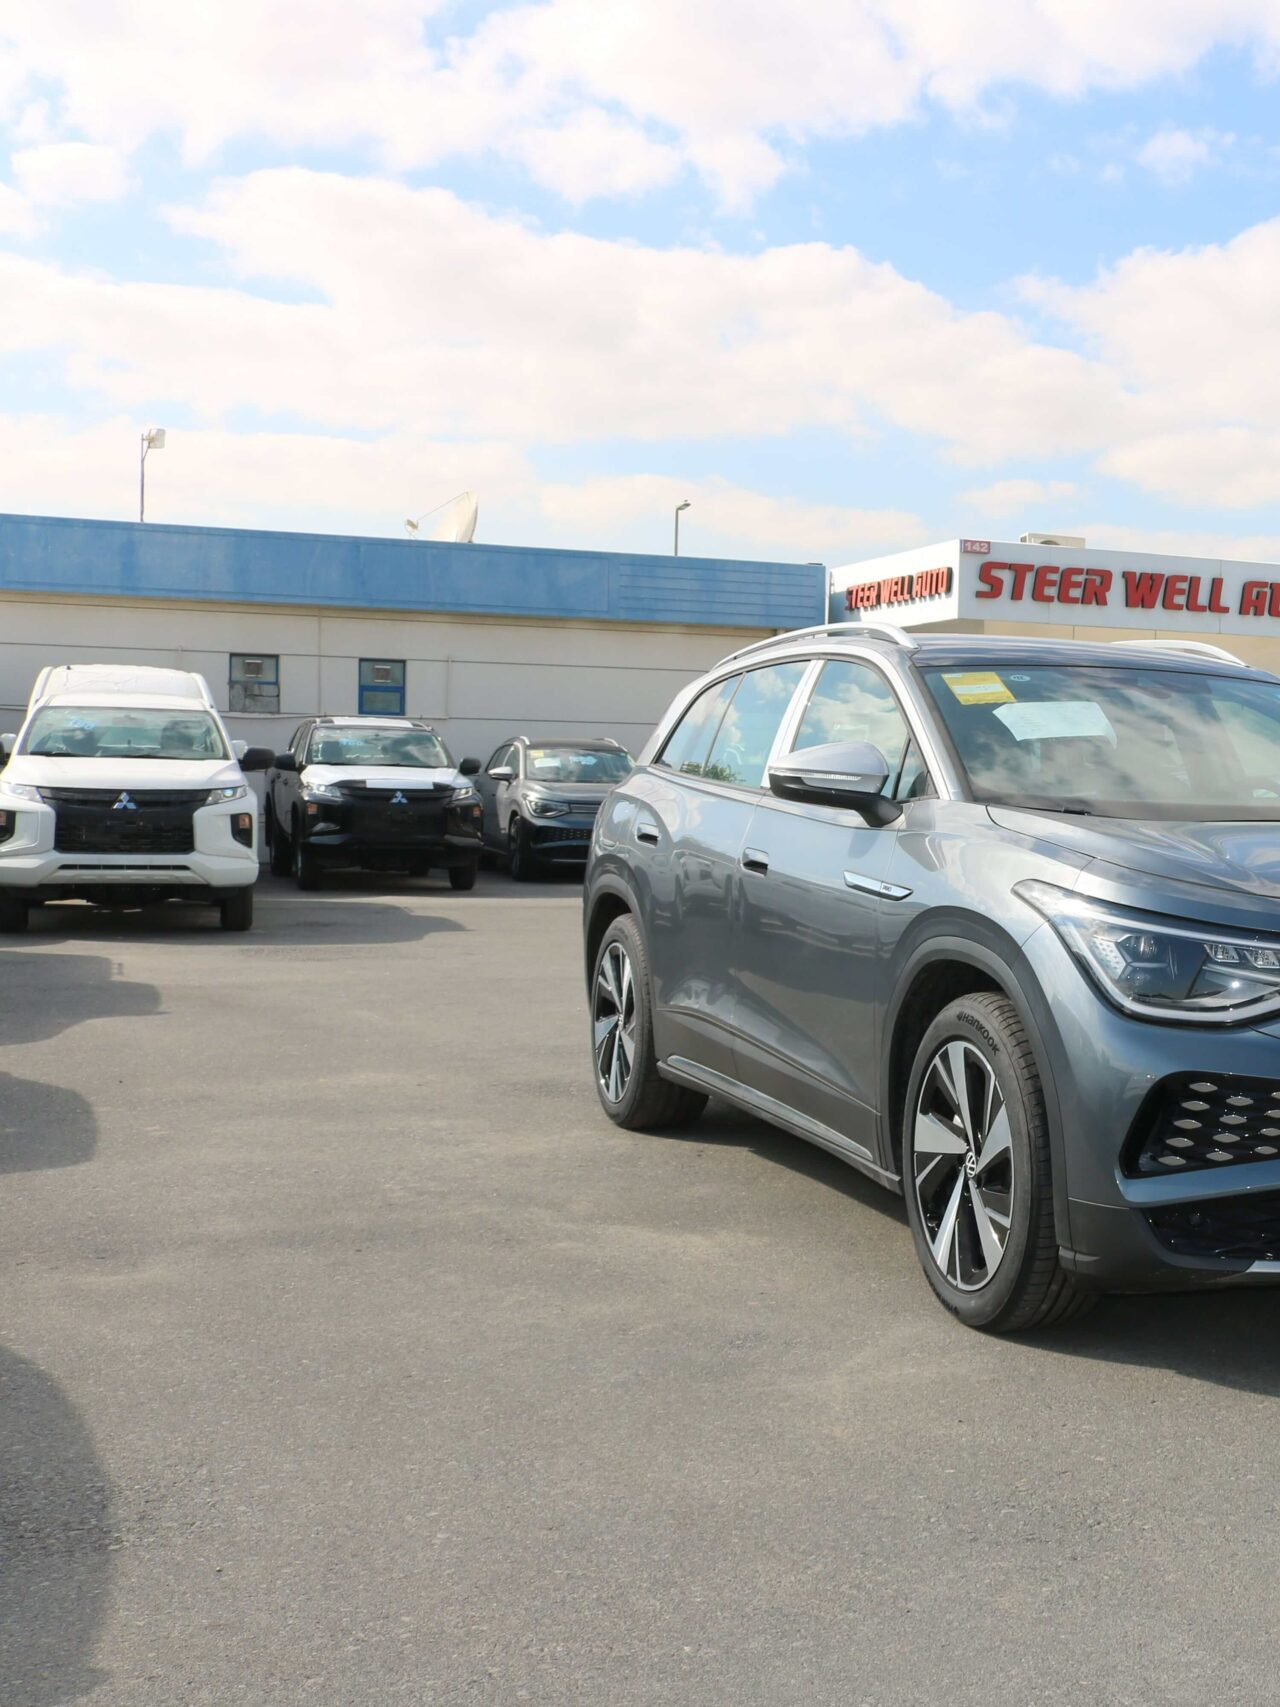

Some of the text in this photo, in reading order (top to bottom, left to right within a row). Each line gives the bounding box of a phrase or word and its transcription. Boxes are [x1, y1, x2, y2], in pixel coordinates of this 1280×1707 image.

[965, 541, 989, 553] 142
[879, 575, 912, 604] WELL
[913, 566, 952, 598] AUTO
[975, 561, 1113, 606] STEER
[1122, 570, 1230, 614] WELL
